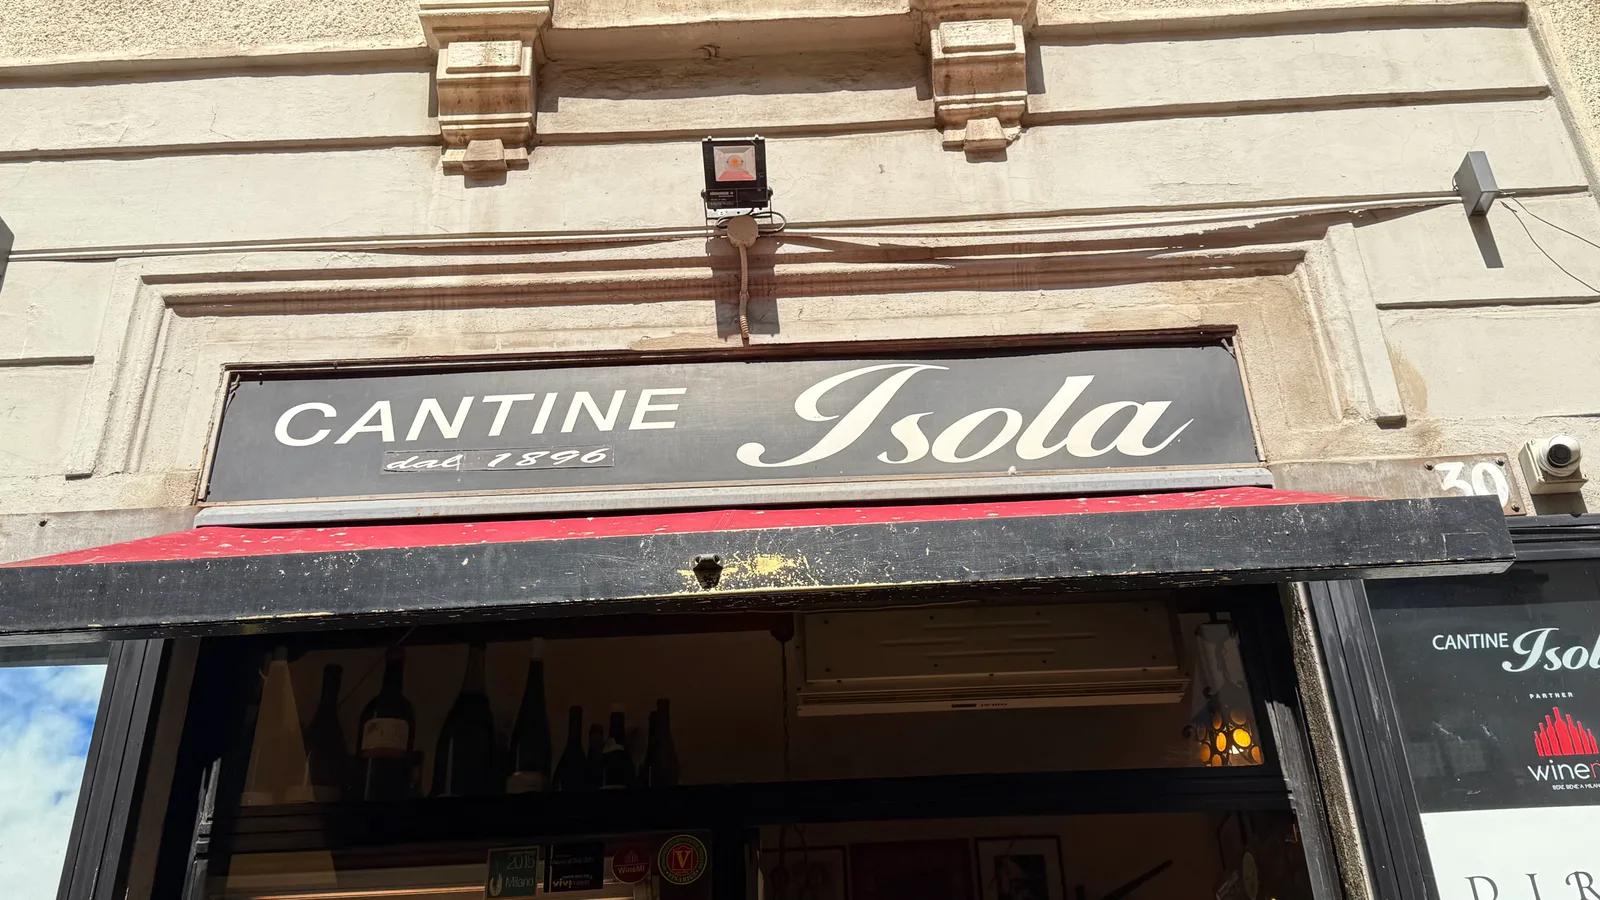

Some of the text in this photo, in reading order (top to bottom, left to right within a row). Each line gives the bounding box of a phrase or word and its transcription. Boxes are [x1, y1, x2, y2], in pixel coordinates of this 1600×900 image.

[273, 363, 1194, 468] CANTINE Isola
[386, 447, 608, 472] dal 1896
[1434, 461, 1509, 508] 30
[1432, 632, 1510, 651] CANTINE
[1529, 690, 1574, 700] PARTNER
[506, 854, 536, 870] 2015
[505, 876, 535, 888] Milano
